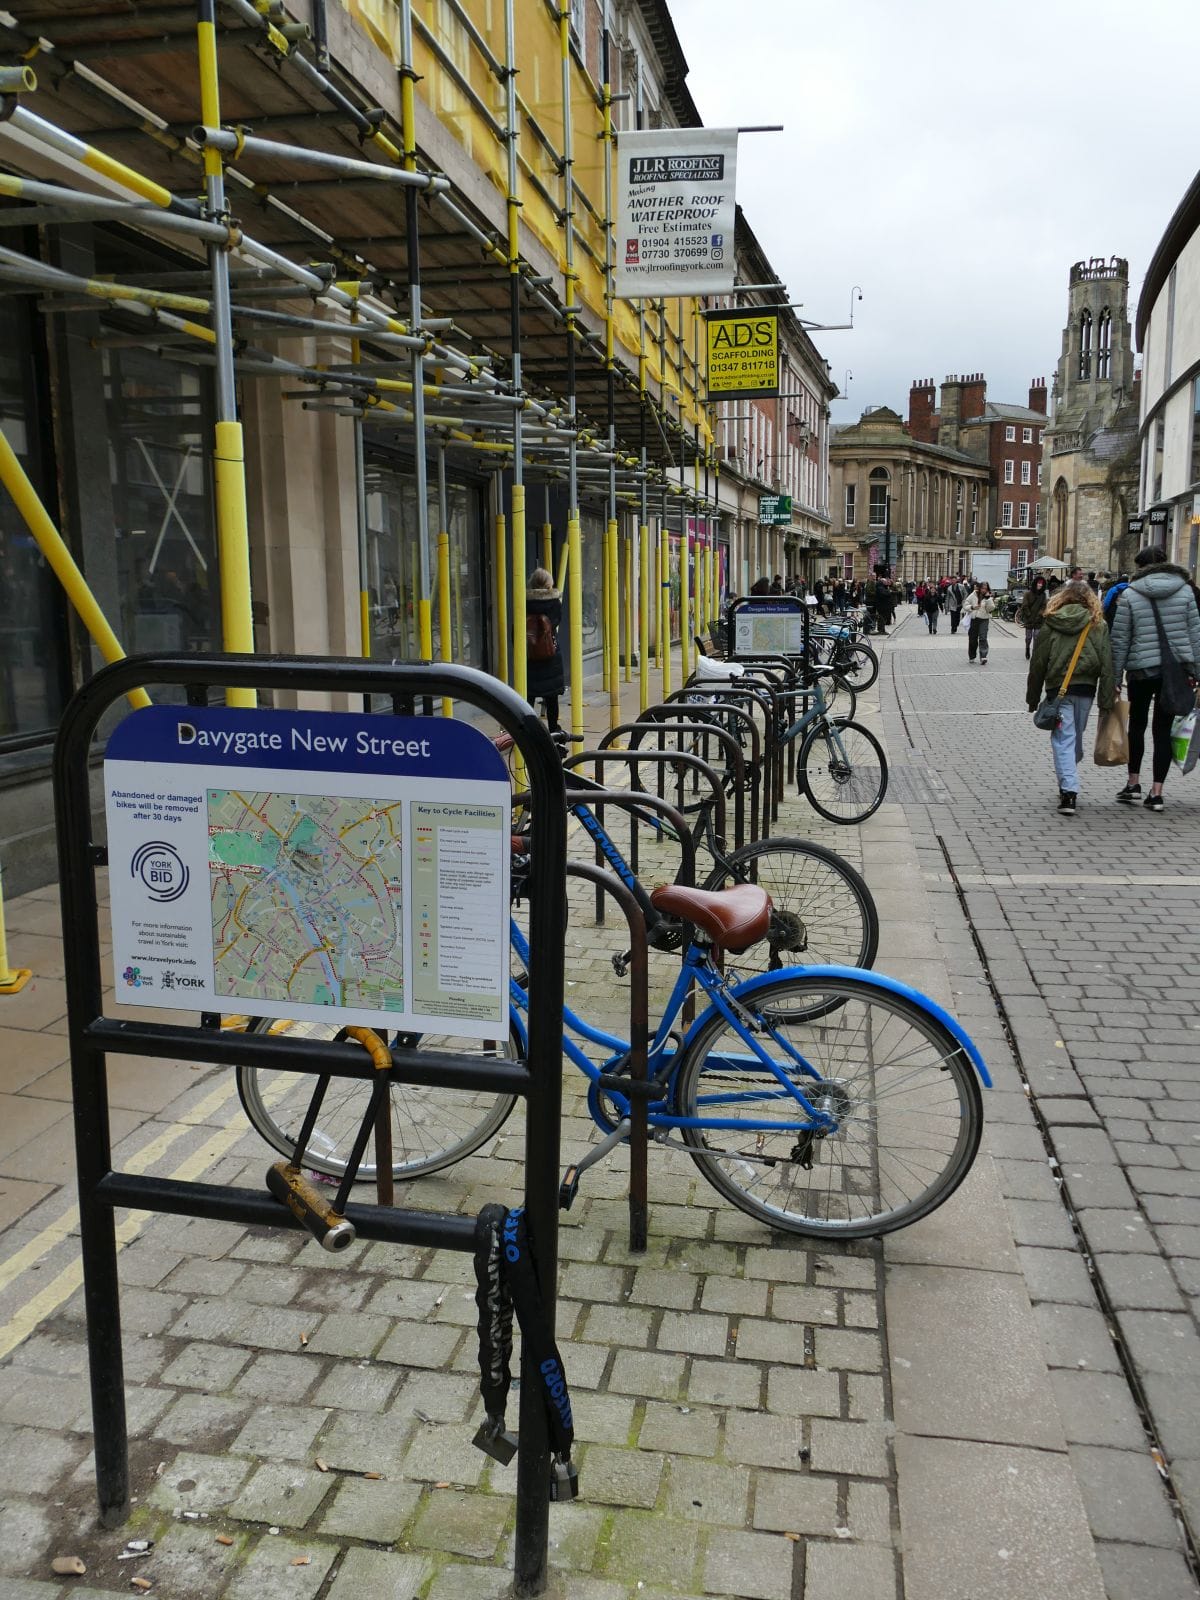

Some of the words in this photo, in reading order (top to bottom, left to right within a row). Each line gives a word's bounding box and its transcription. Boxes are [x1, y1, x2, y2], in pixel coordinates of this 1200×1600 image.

[633, 158, 666, 173] JLR
[668, 157, 720, 169] ROOFING
[633, 172, 668, 182] ROOFING
[669, 171, 720, 180] SPECIALISTS
[628, 184, 656, 198] Making
[627, 195, 685, 209] ANOTHER
[690, 195, 725, 206] ROOF
[631, 208, 720, 223] WATERPROOF
[638, 224, 660, 234] Free
[663, 222, 712, 233] Estimates
[641, 238, 670, 248] 01904
[674, 236, 708, 246] 415523
[641, 249, 670, 259] 07730
[674, 247, 708, 258] 370699
[625, 261, 724, 273] www.jlrroofingyork.com
[712, 321, 773, 349] ADS
[711, 349, 774, 360] SCAFFOLDING
[710, 362, 739, 373] 01347
[741, 360, 775, 371] 811718
[177, 722, 282, 755] Davygate
[291, 728, 348, 753] New
[356, 731, 431, 758] Street
[111, 790, 155, 800] Abandoned
[167, 794, 203, 804] damaged
[116, 801, 137, 809] bikes
[153, 803, 163, 811] be
[165, 804, 199, 813] removed
[417, 806, 431, 815] Key
[442, 807, 463, 816] Cycle
[464, 809, 496, 818] Facilities
[133, 812, 151, 820] after
[152, 813, 162, 821] 30
[163, 813, 183, 823] days
[150, 860, 173, 869] YORK
[150, 871, 173, 883] BID
[160, 923, 193, 932] information
[156, 931, 187, 940] sustainable
[160, 939, 175, 947] York
[131, 954, 197, 966] www.itravelyork.info
[175, 977, 206, 989] YORK
